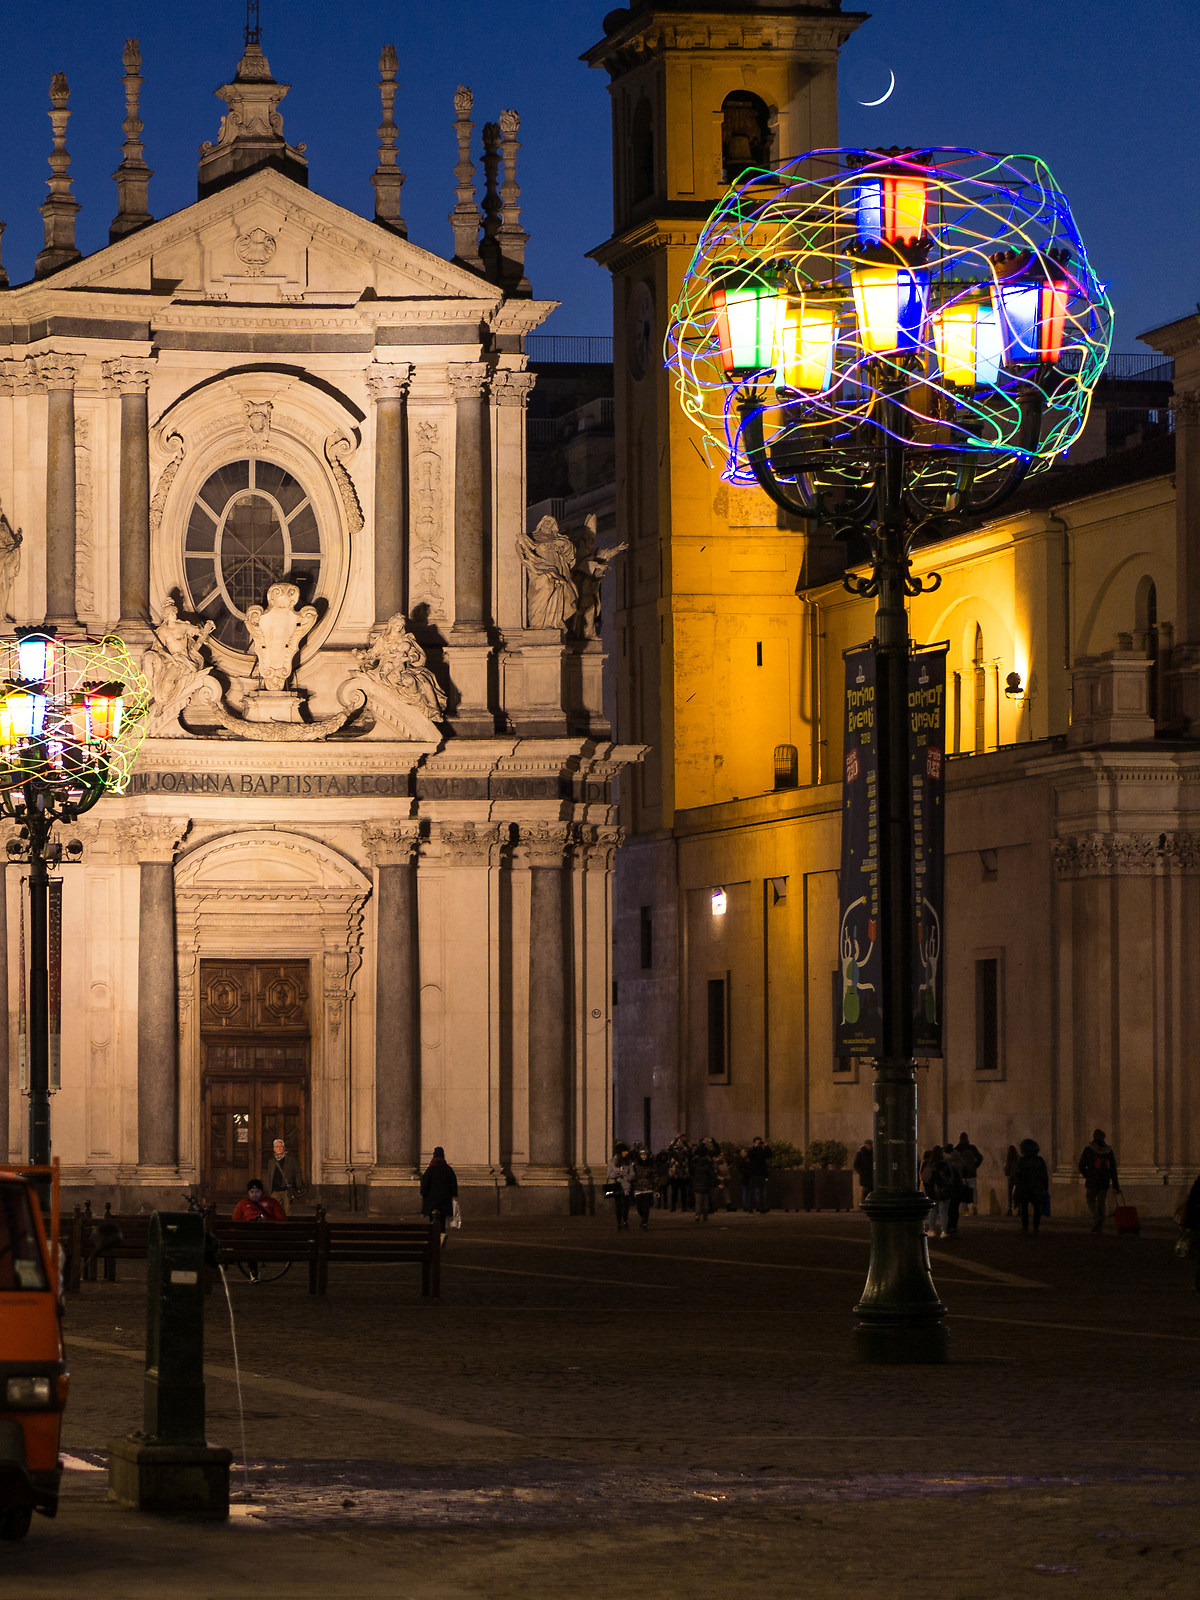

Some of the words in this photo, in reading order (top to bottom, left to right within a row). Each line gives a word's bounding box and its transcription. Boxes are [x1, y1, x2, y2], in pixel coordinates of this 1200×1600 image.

[846, 685, 875, 710] Torino
[848, 706, 874, 732] Eventi
[150, 772, 234, 792] JOANNA
[240, 775, 342, 793] BAPTISTA
